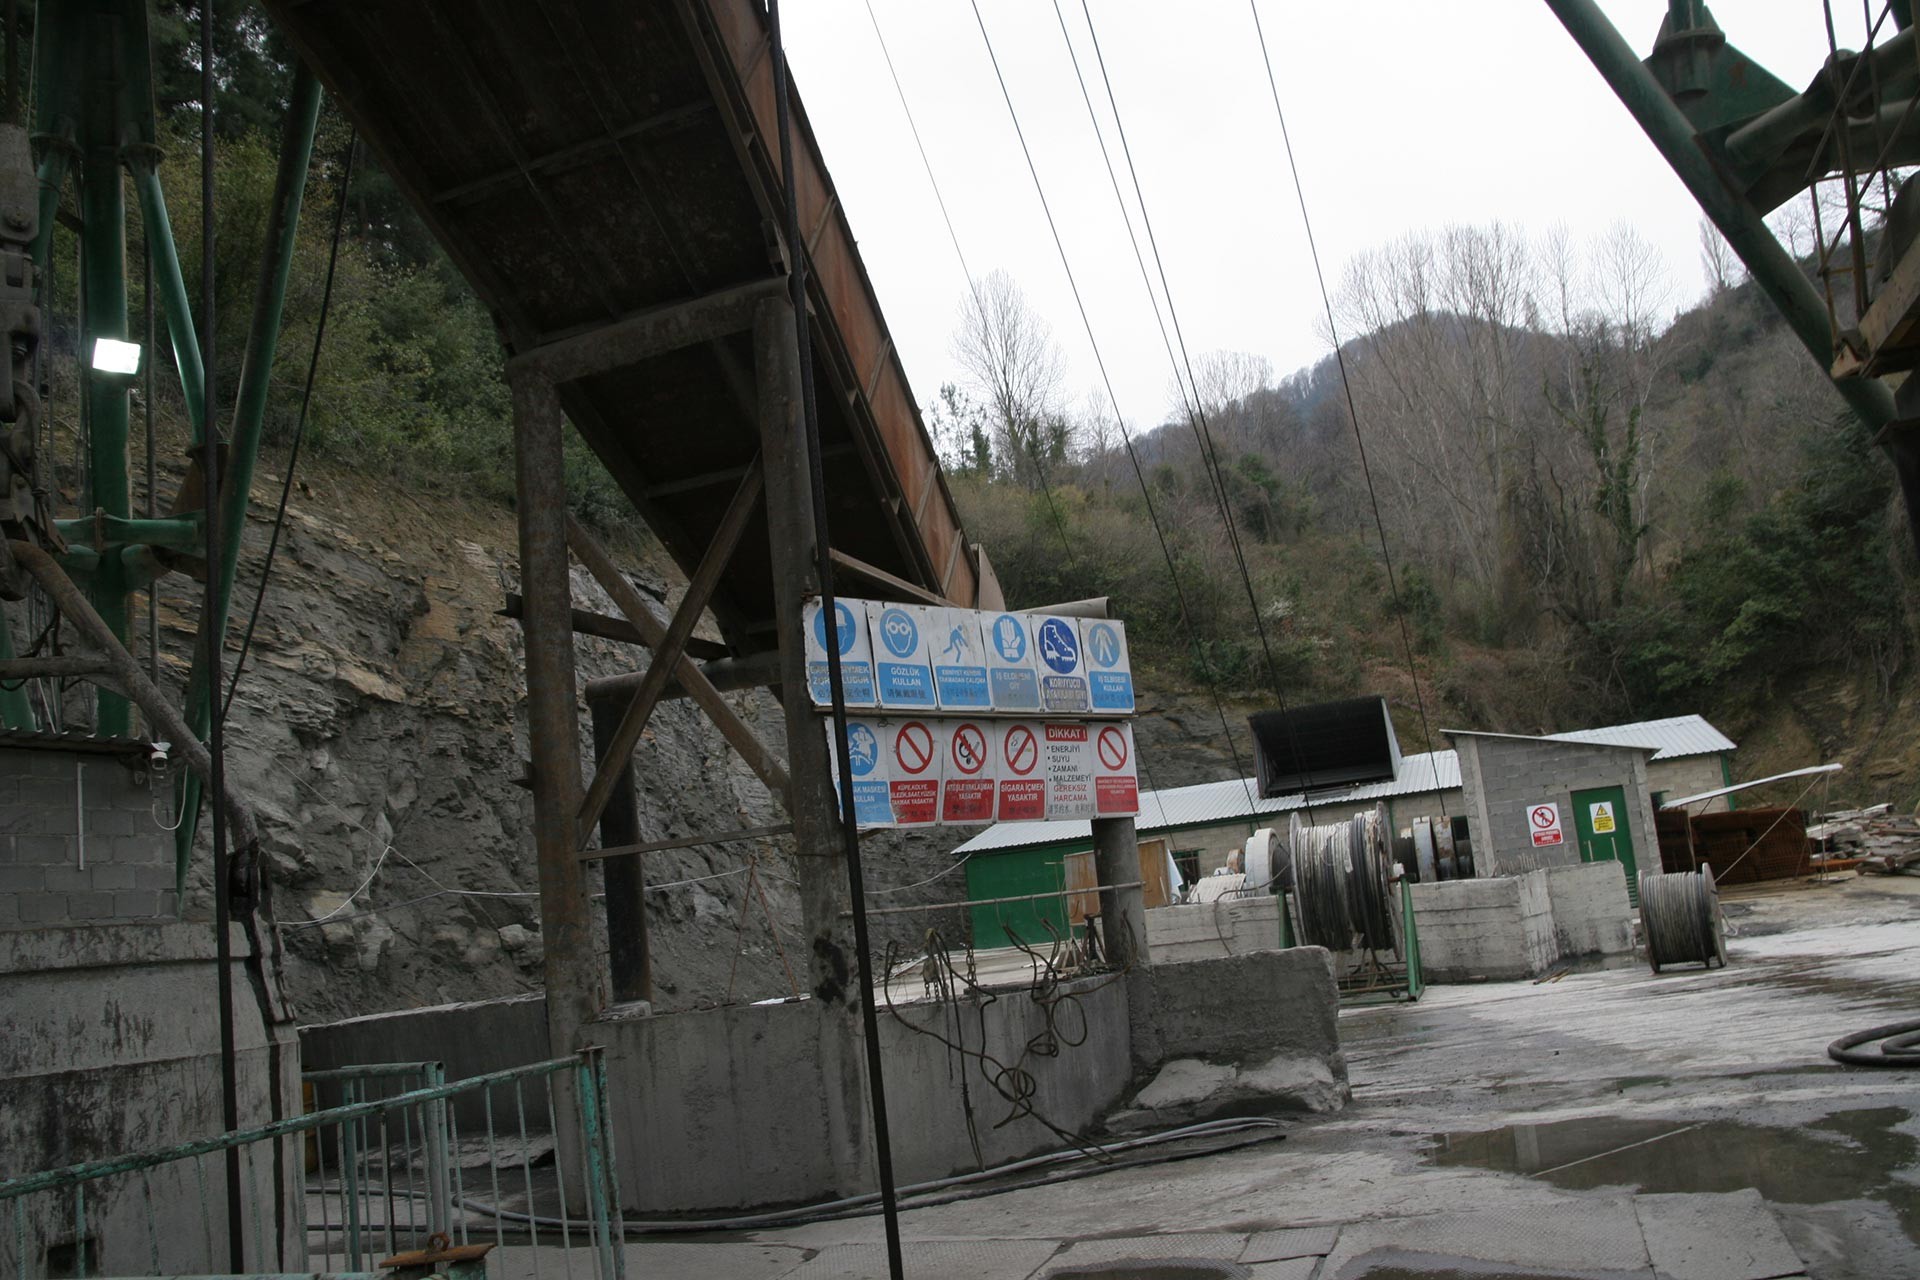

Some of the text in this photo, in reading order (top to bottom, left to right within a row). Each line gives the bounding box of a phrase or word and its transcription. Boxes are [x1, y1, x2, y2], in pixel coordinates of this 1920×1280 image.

[890, 666, 920, 676] GÖZLÜK
[892, 677, 921, 687] KULLAN
[1048, 726, 1080, 738] DİKKAT
[1051, 744, 1080, 753] ENERJİYİ
[1053, 773, 1091, 782] MALZEMEYİ
[1001, 782, 1044, 792] SİGARA İÇMEK
[1054, 783, 1087, 792] GEREKSİZ
[1008, 793, 1038, 801] YASAKTIR
[1054, 794, 1088, 802] HARCAMA
